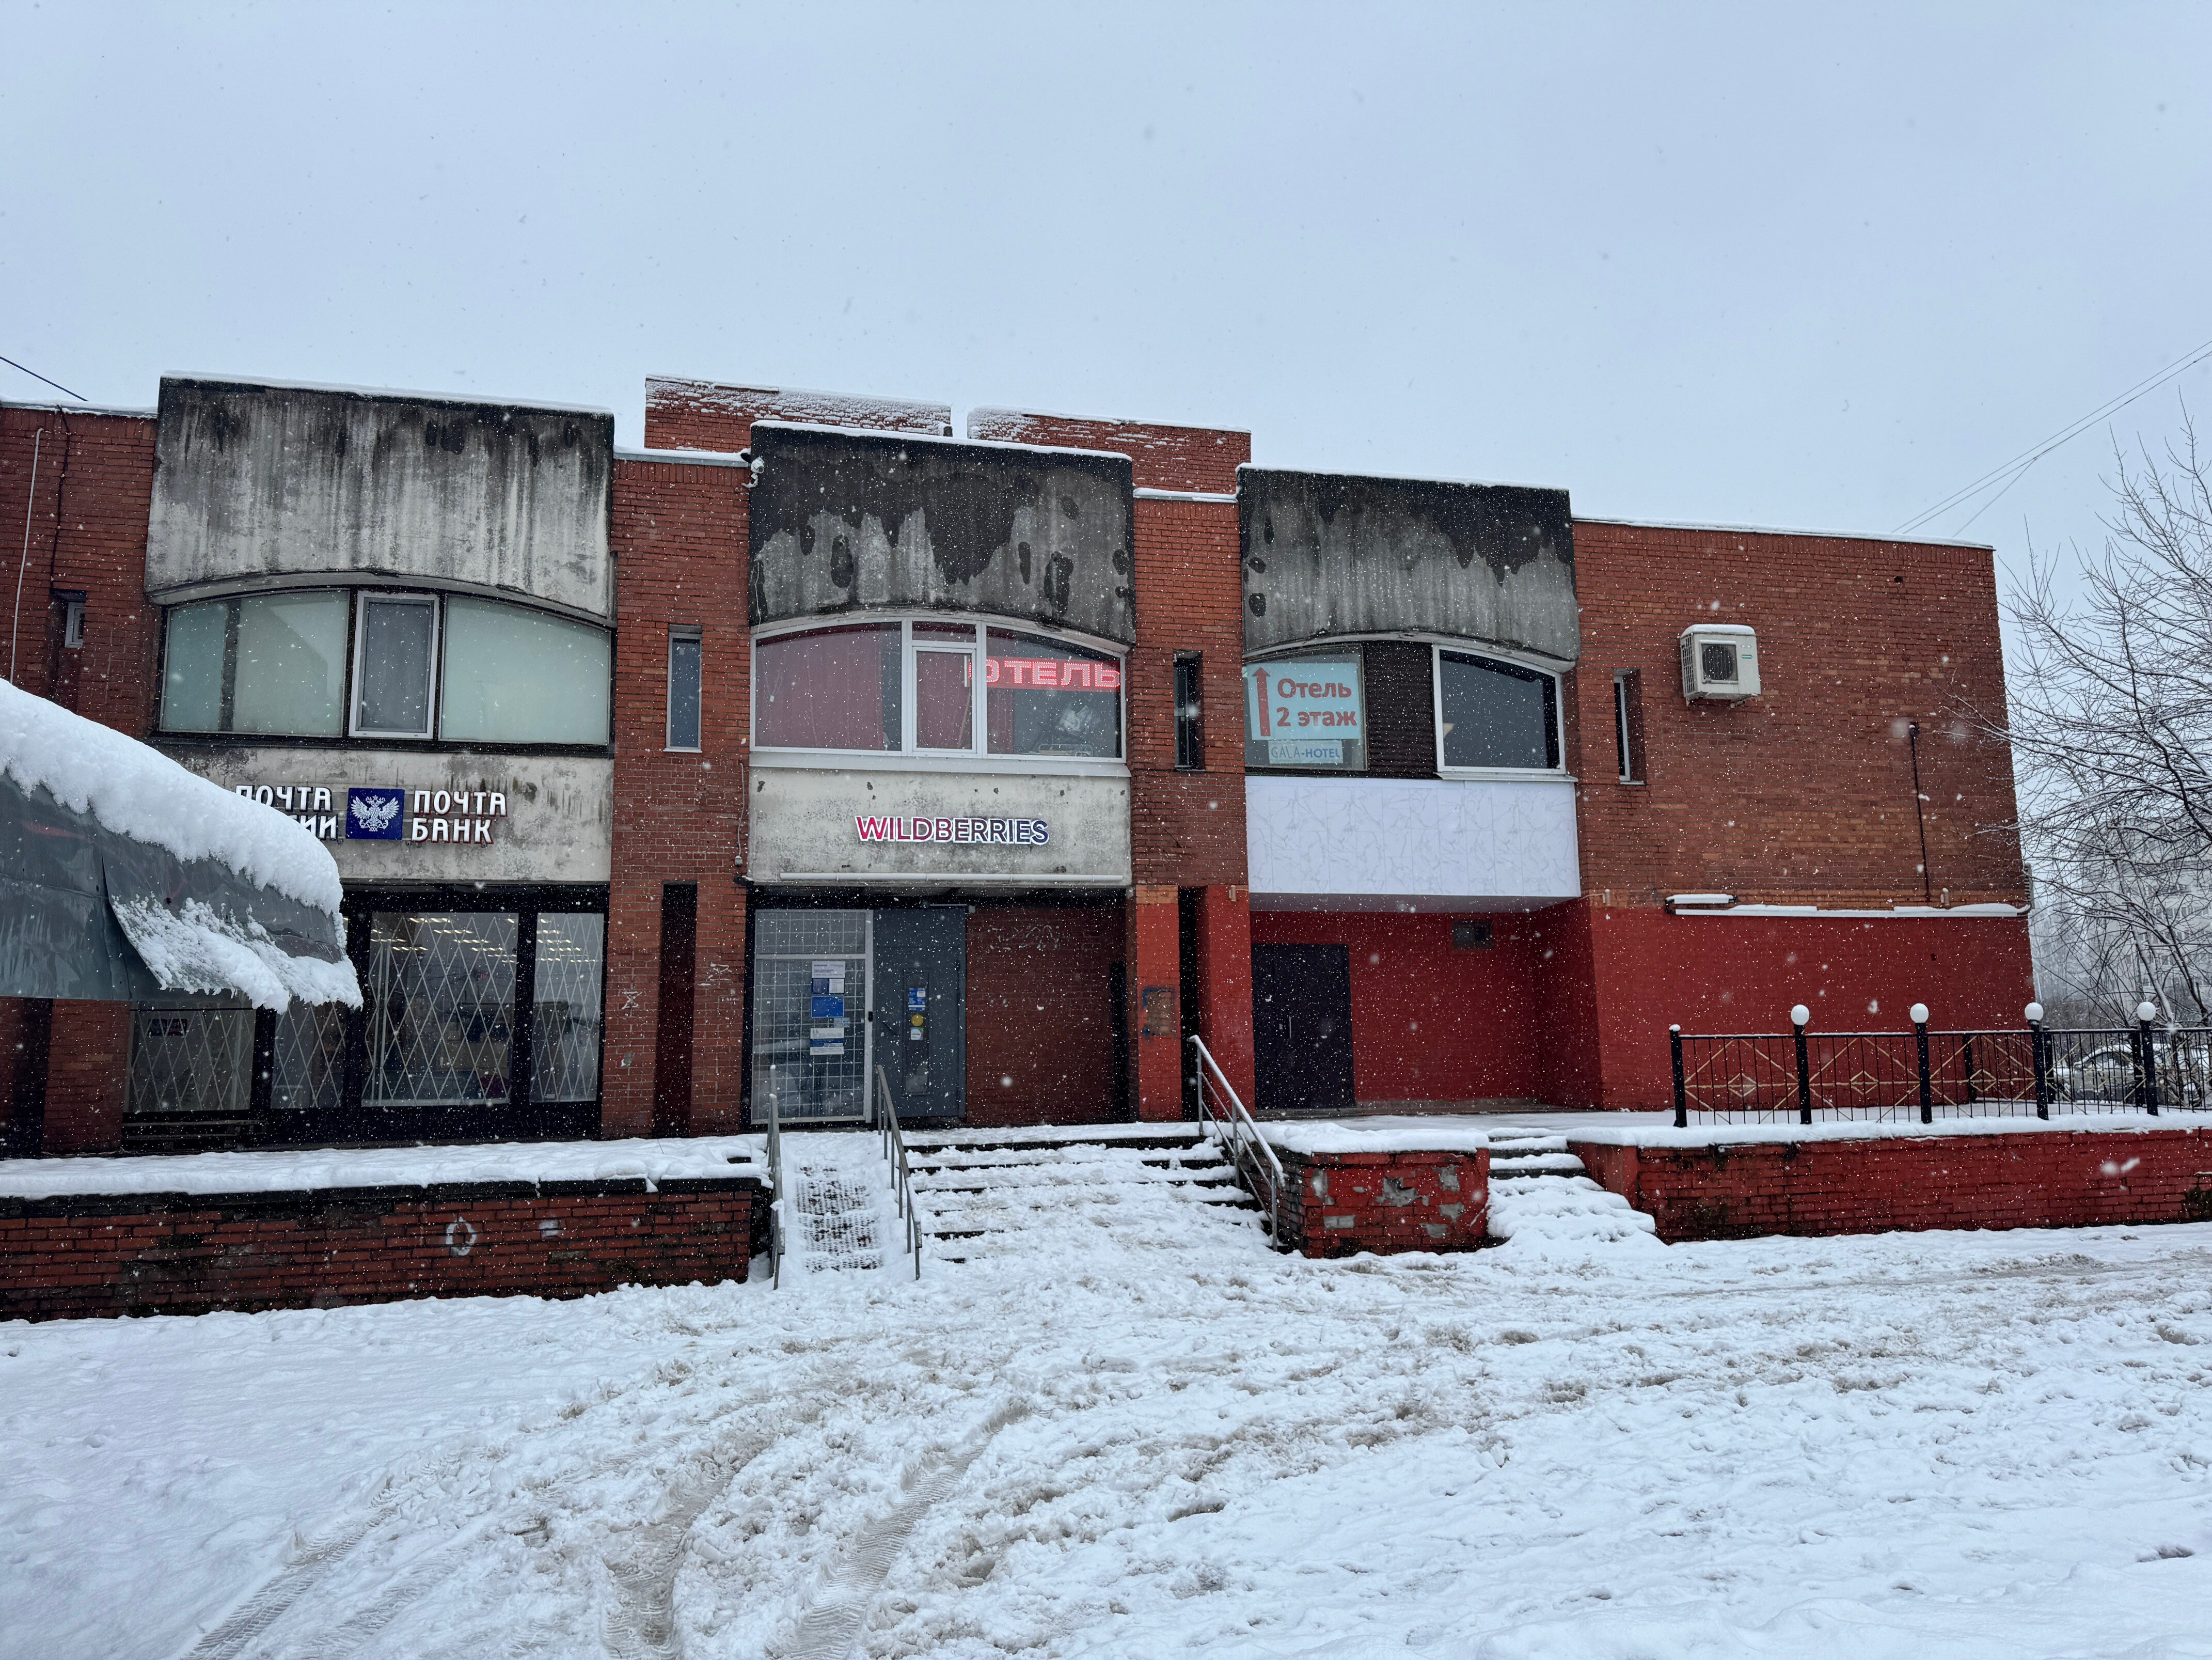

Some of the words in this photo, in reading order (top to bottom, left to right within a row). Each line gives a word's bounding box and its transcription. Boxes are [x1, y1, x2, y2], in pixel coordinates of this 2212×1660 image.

[1277, 678, 1352, 698] Отель
[1276, 707, 1291, 727] 2
[1297, 711, 1357, 727] этаж
[1271, 745, 1340, 759] GALA-HOTEL
[413, 790, 507, 817] ПОЧТА
[411, 817, 494, 844] БАНК
[855, 816, 1049, 845] WILDBERRIES
